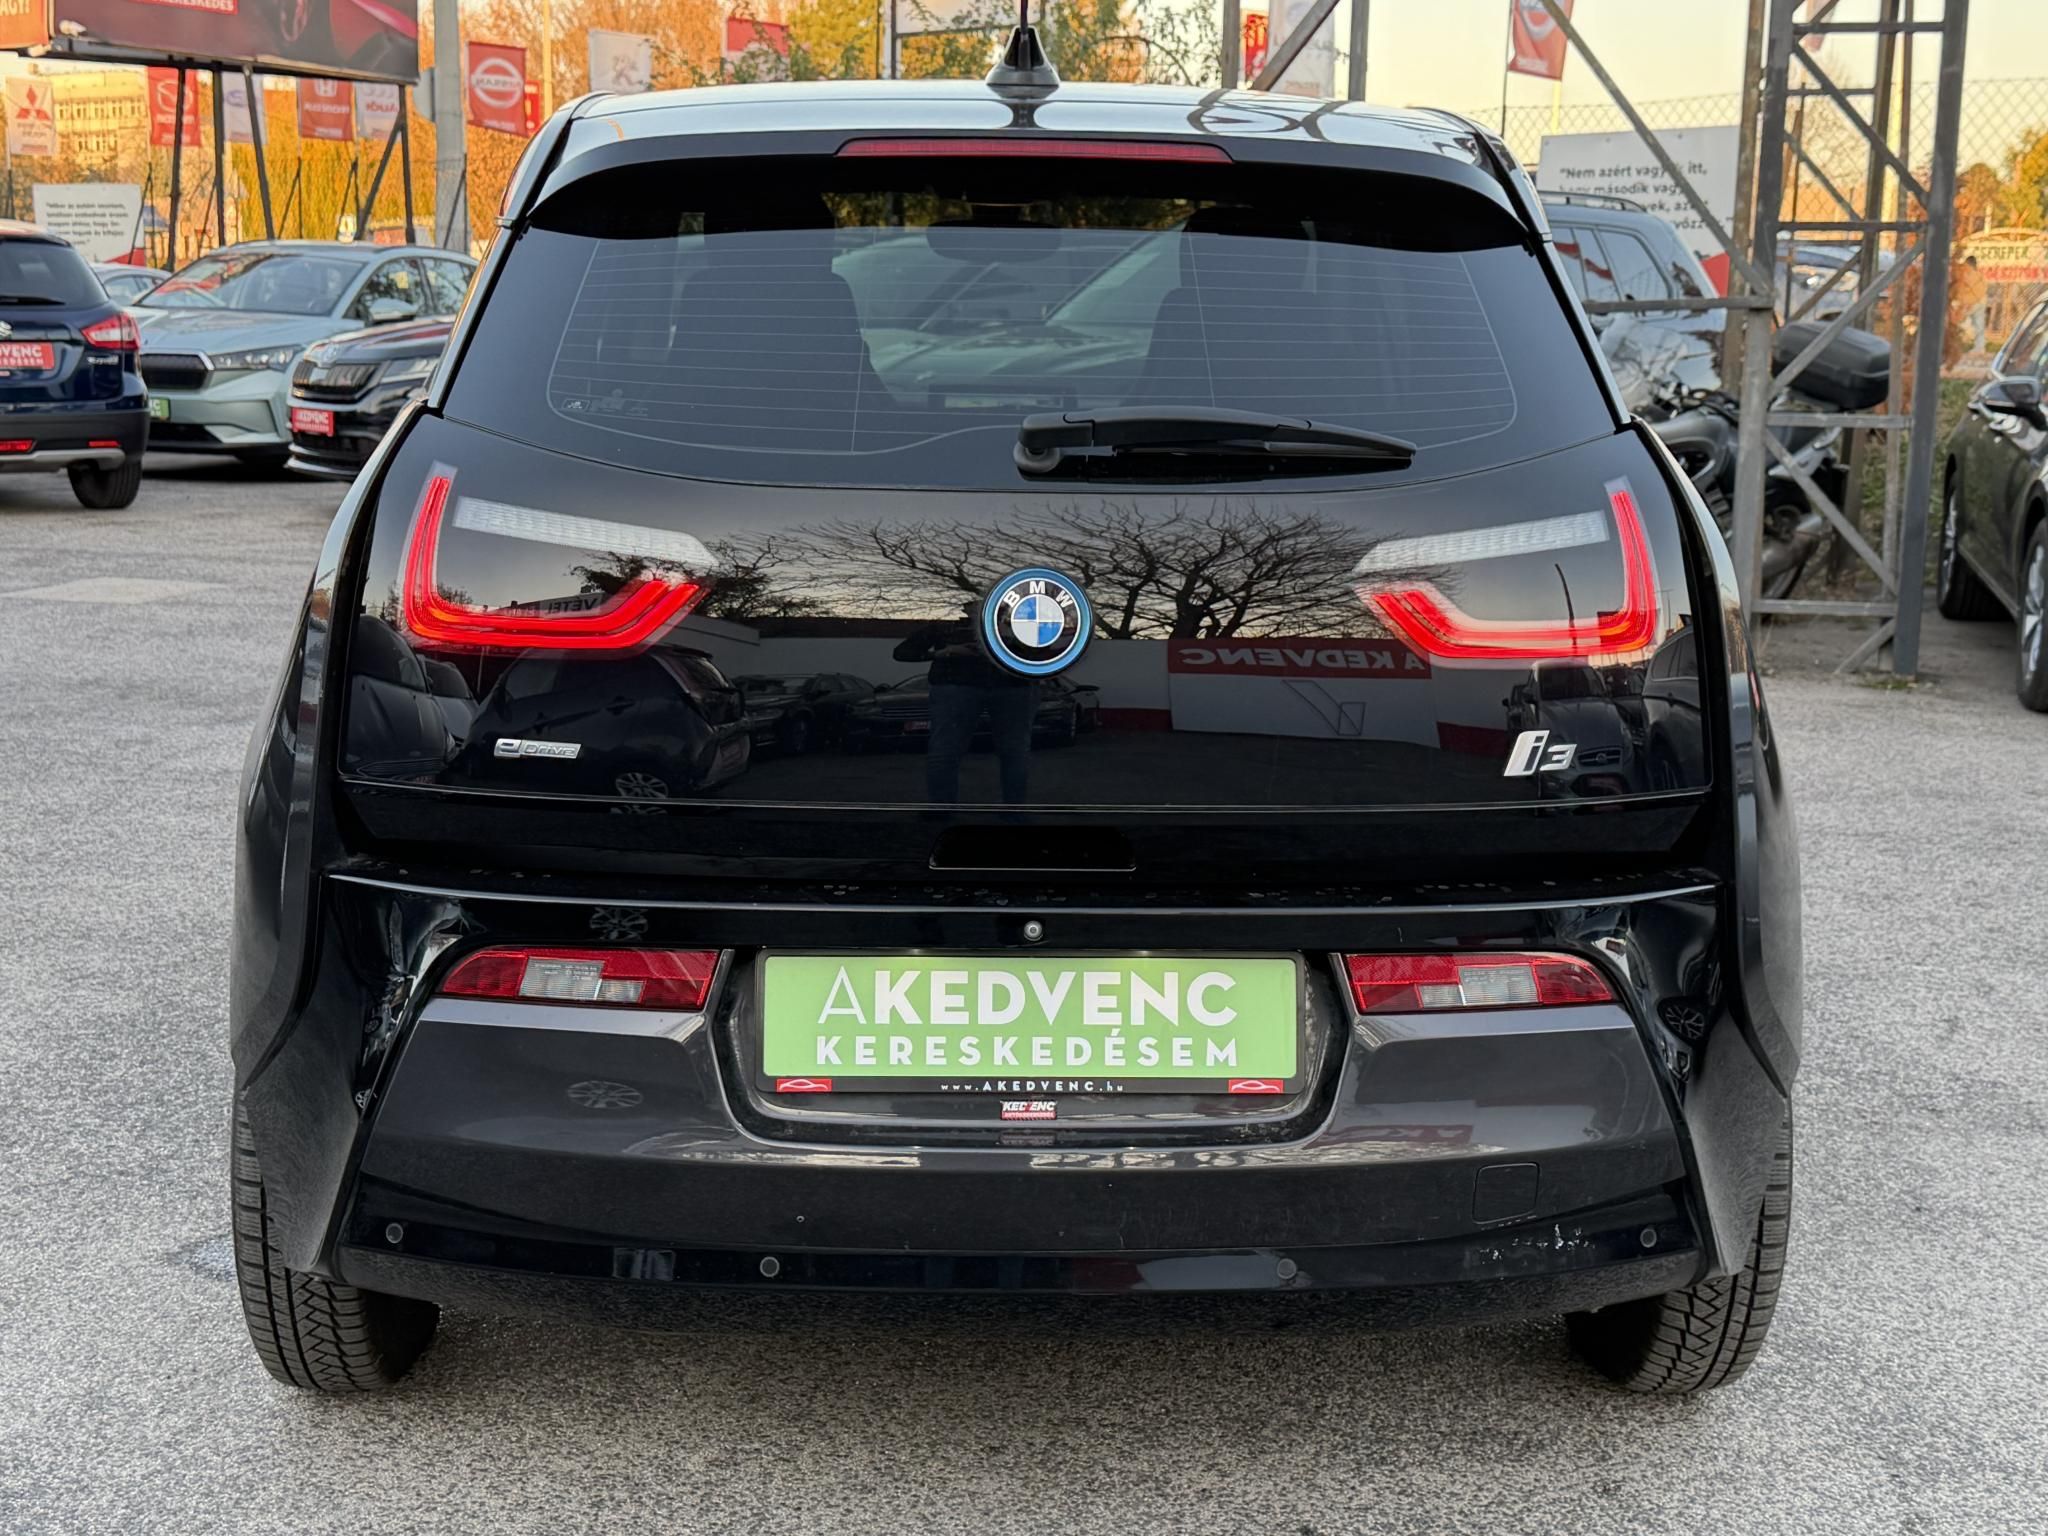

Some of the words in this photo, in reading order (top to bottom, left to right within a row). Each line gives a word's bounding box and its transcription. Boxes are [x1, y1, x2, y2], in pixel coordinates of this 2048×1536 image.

[1598, 165, 1632, 178] azért
[1688, 161, 1708, 176] itt,
[1594, 181, 1649, 194] második
[0, 344, 42, 357] VENC
[1003, 581, 1074, 608] BMW
[1503, 729, 1577, 776] i3
[816, 1028, 1238, 1067] KERESKEDÉSEM
[940, 1080, 1124, 1092] www.AKEDVENC.hu
